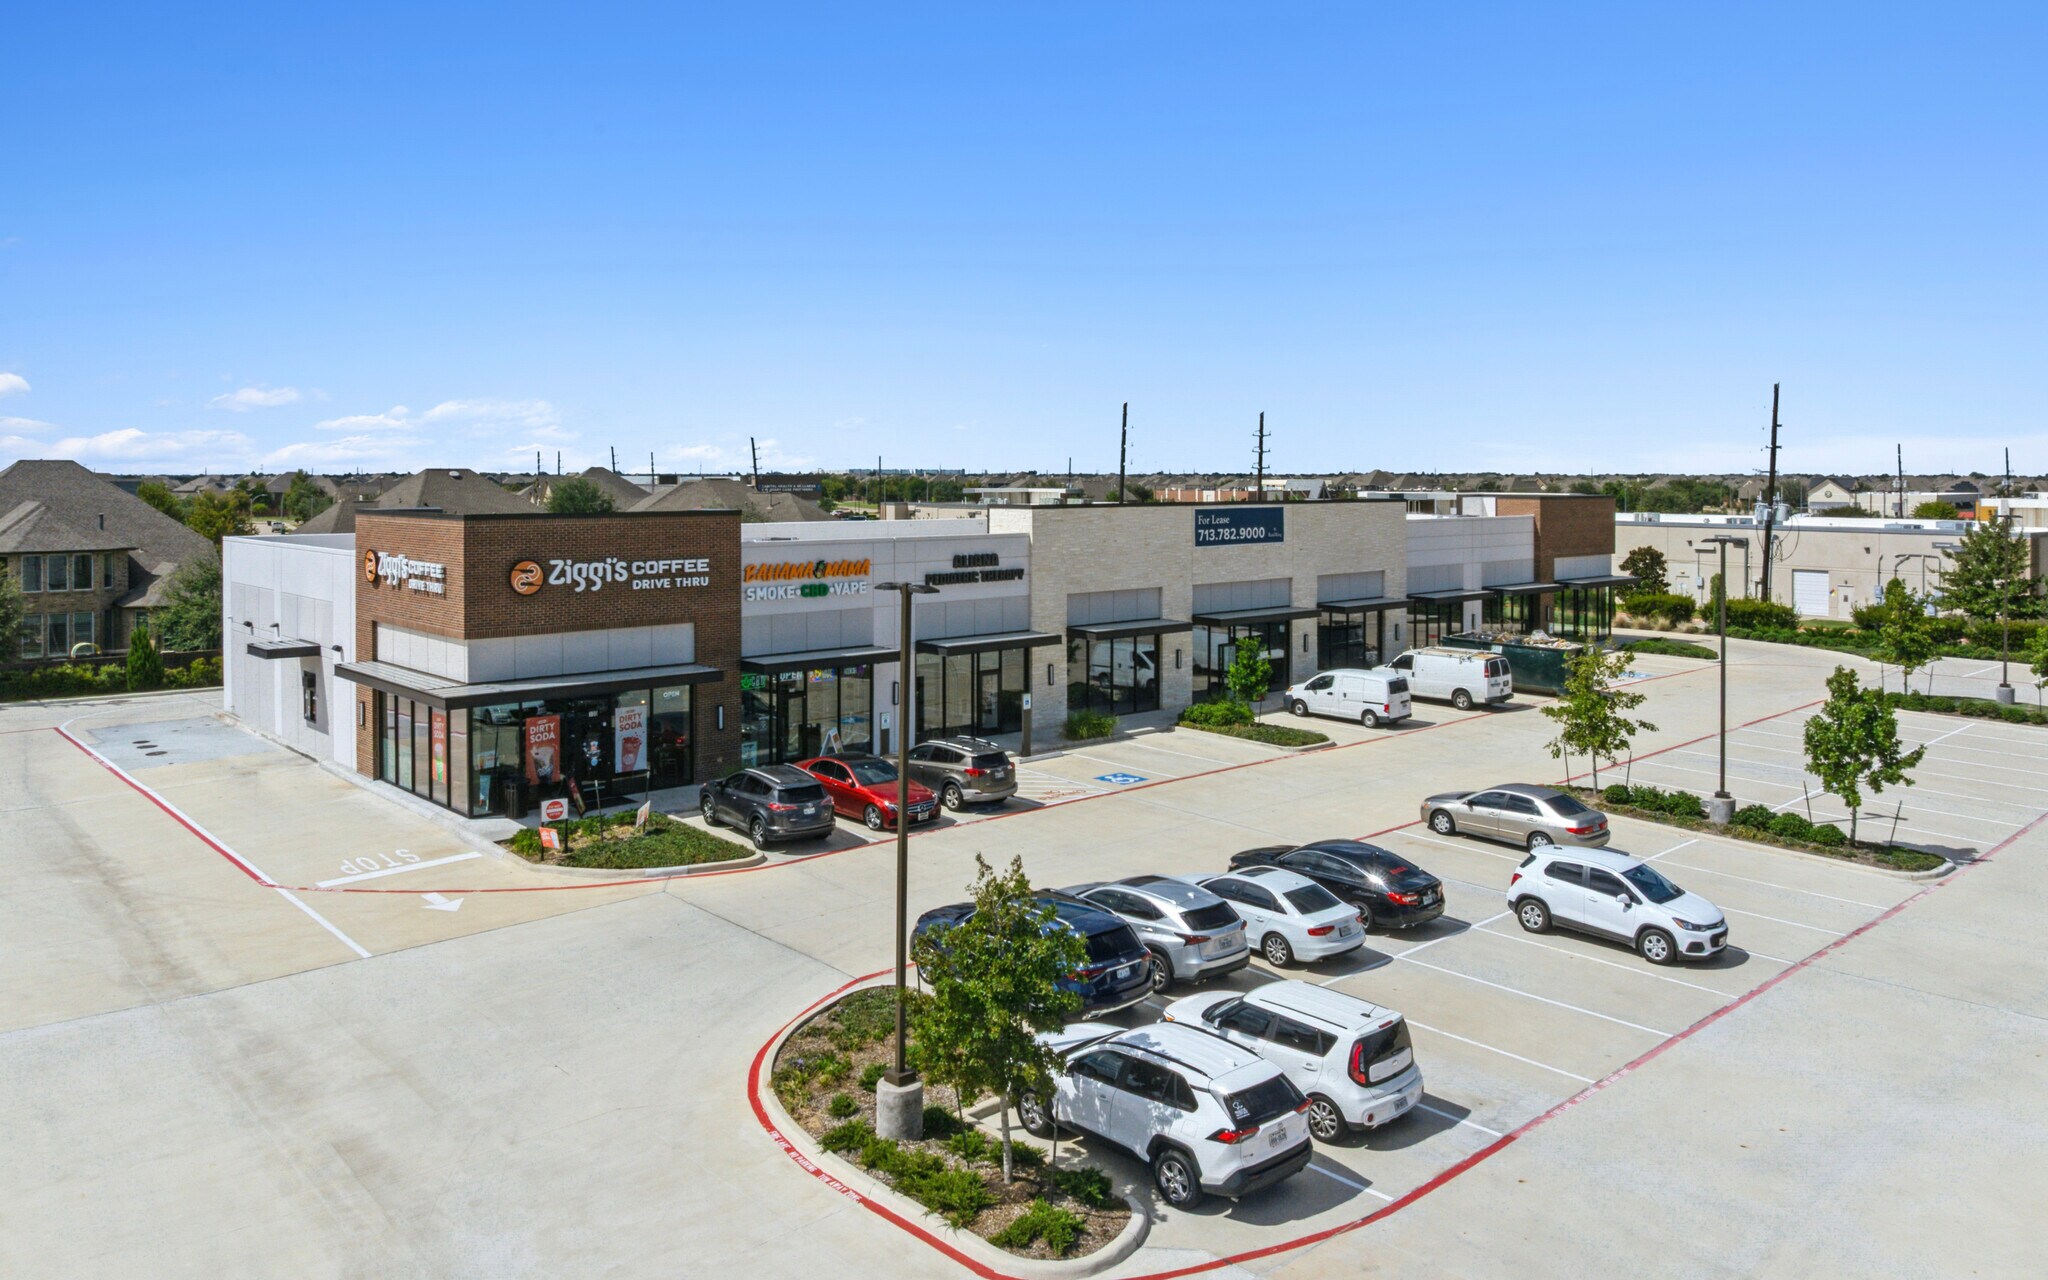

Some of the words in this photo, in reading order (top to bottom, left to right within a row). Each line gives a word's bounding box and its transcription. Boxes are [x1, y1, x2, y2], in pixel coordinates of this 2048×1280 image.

[1198, 515, 1210, 525] For
[1212, 515, 1230, 524] Lease
[1198, 527, 1265, 541] 713.782.9000
[378, 552, 409, 585] Ziggi's
[408, 560, 445, 578] COFFEE
[631, 558, 709, 575] COFFEE
[744, 561, 814, 583] BAHAMA
[824, 558, 870, 578] MAMA
[548, 557, 628, 592] Ziggi's
[925, 571, 979, 586] PEDIATRIC
[979, 568, 1024, 582] THERAPY
[409, 579, 427, 591] DRIVE
[427, 582, 444, 594] THRU
[632, 578, 671, 590] DRIVE
[675, 577, 709, 587] THRU
[746, 585, 796, 601] SMOKE
[800, 583, 829, 598] CBD
[833, 581, 867, 595] VAPE
[663, 690, 680, 698] OPEN
[620, 712, 642, 723] DIRTY
[530, 723, 555, 734] DIRTY
[620, 721, 642, 732] SODA
[530, 732, 555, 743] SODA
[340, 849, 421, 875] STOP
